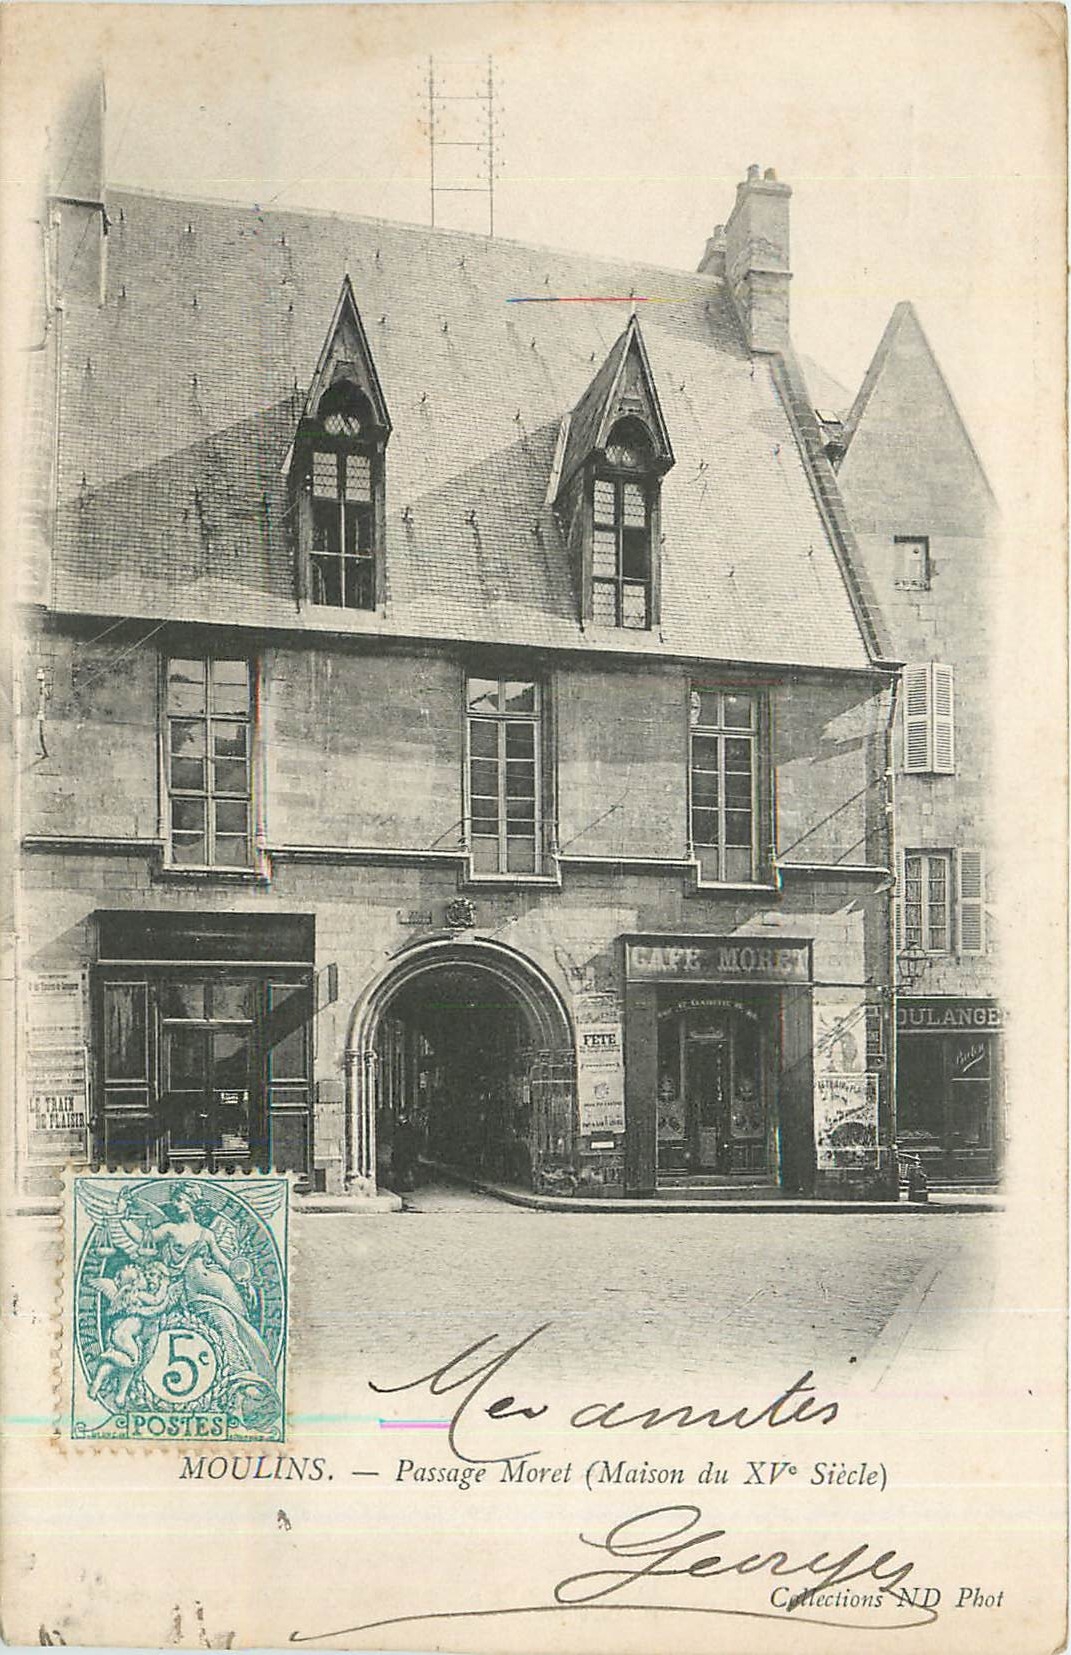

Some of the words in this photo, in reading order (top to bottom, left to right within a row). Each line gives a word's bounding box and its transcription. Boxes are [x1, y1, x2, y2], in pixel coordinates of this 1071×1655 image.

[717, 946, 808, 973] MORET
[30, 1096, 40, 1113] LE
[46, 1096, 74, 1113] TRAIN
[50, 1112, 85, 1129] PLAISIR
[132, 1415, 223, 1437] POSTES
